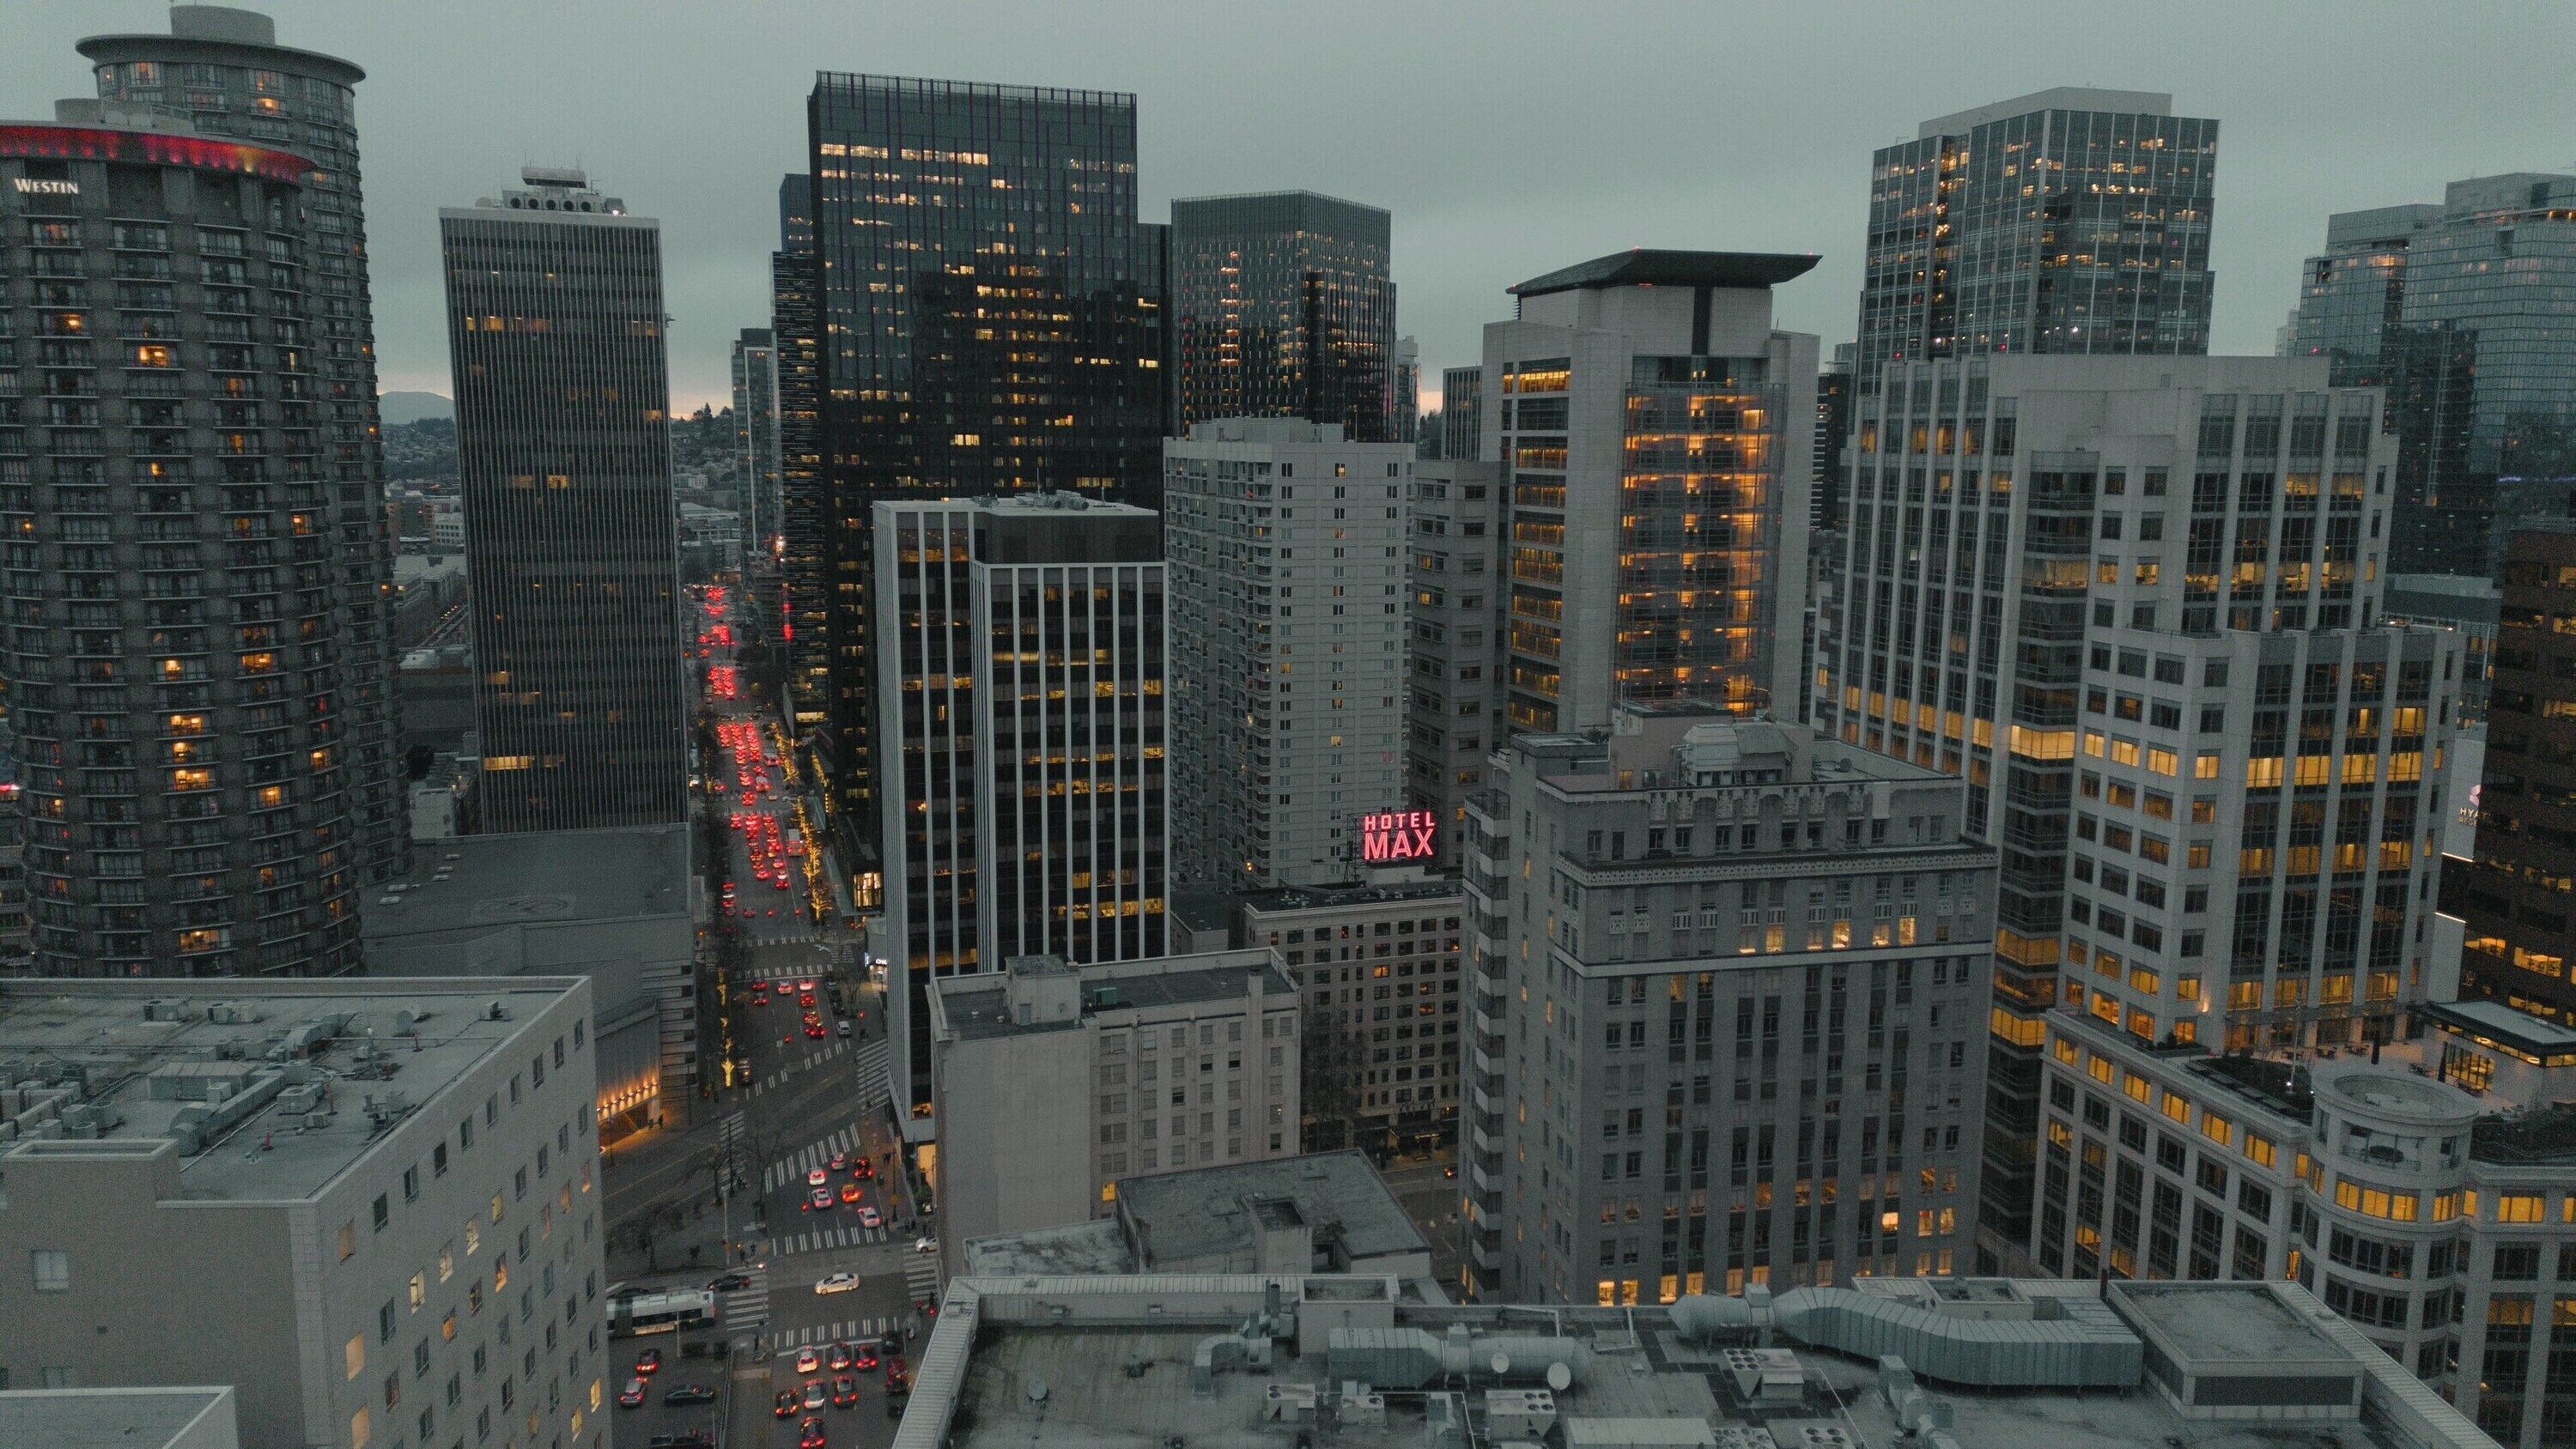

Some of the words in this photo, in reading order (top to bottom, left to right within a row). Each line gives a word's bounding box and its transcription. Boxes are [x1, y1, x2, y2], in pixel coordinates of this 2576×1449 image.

[14, 178, 79, 194] WESTIN
[1364, 812, 1435, 830] HOTEL
[1364, 828, 1434, 860] MAX
